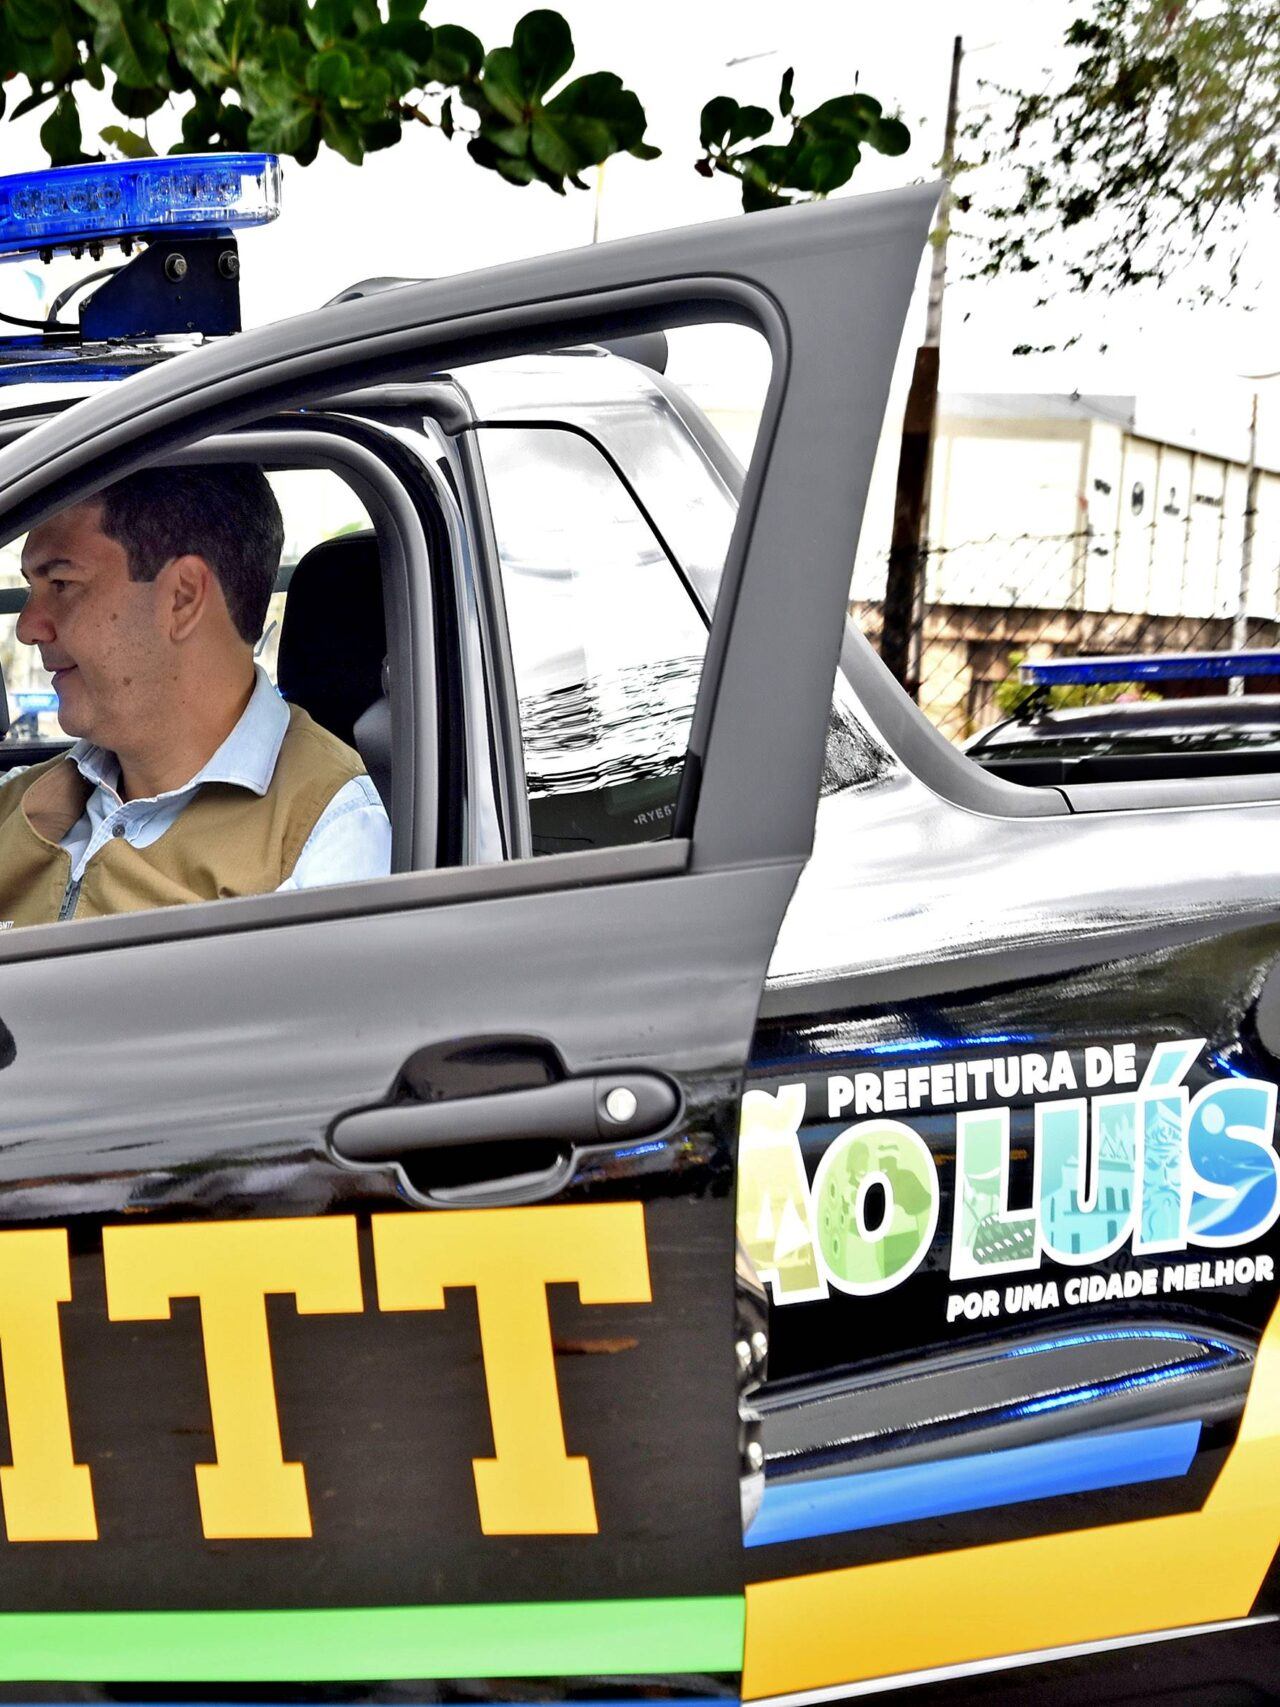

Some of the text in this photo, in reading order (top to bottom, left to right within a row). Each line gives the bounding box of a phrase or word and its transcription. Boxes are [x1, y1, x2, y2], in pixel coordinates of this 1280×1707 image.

[827, 1042, 1137, 1118] PREFEITURA DE
[738, 1038, 1280, 1306] ÃO LUÍS
[946, 1255, 1274, 1323] POR UMA CIDADE MELHOR
